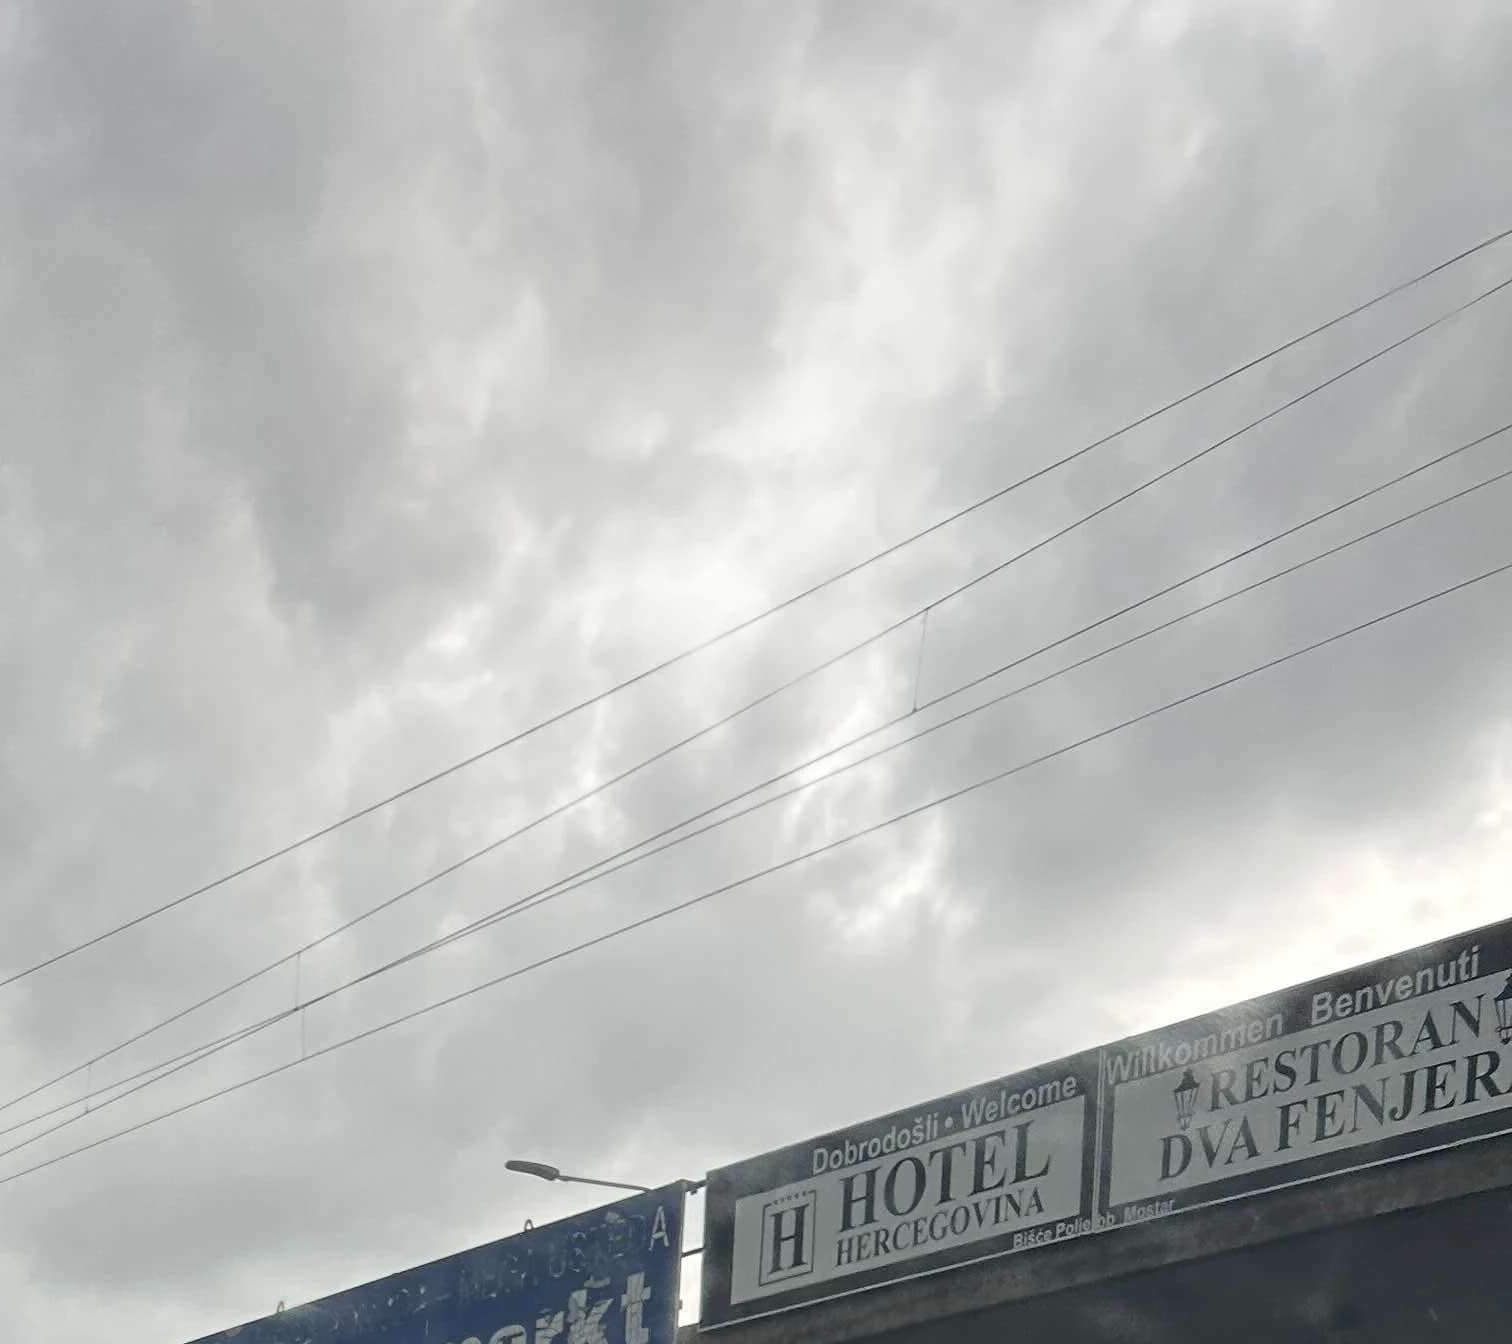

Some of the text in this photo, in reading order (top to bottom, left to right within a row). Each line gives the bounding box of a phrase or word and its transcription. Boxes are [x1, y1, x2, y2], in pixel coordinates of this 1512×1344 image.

[1106, 945, 1480, 1086] Willkommen Benvenuti
[1207, 993, 1487, 1112] RESTORAN
[812, 1075, 1077, 1176] Dobrodošli Welcome
[1157, 1049, 1512, 1182] DVA FENJER
[835, 1186, 1045, 1267] HERCEGOVINA
[838, 1119, 1051, 1233] HOTEL
